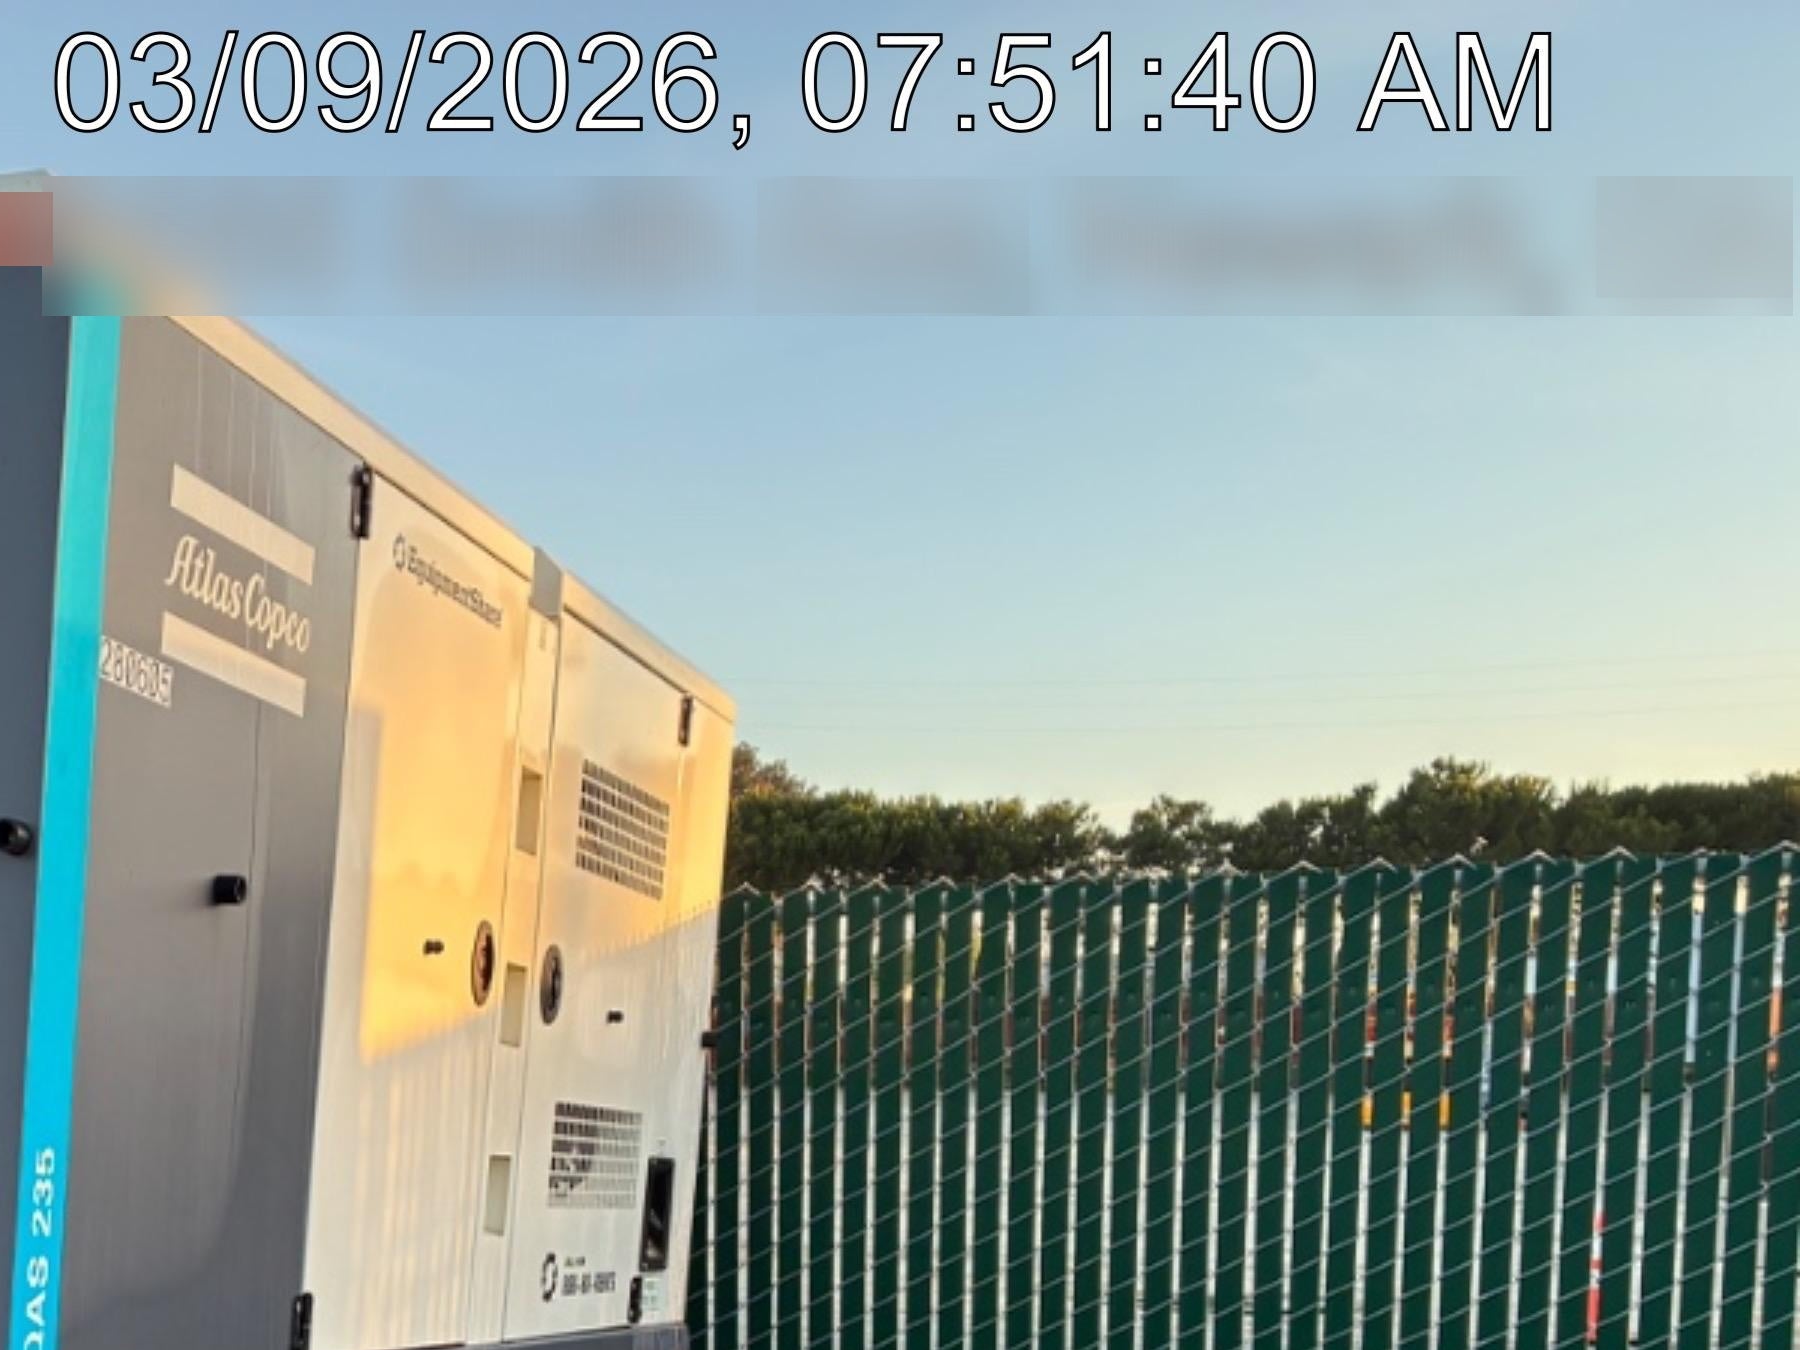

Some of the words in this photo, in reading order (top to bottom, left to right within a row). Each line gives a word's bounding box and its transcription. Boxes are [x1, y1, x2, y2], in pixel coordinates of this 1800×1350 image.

[165, 534, 245, 620] Atlas
[243, 571, 312, 654] Copco
[31, 1146, 55, 1237] 235
